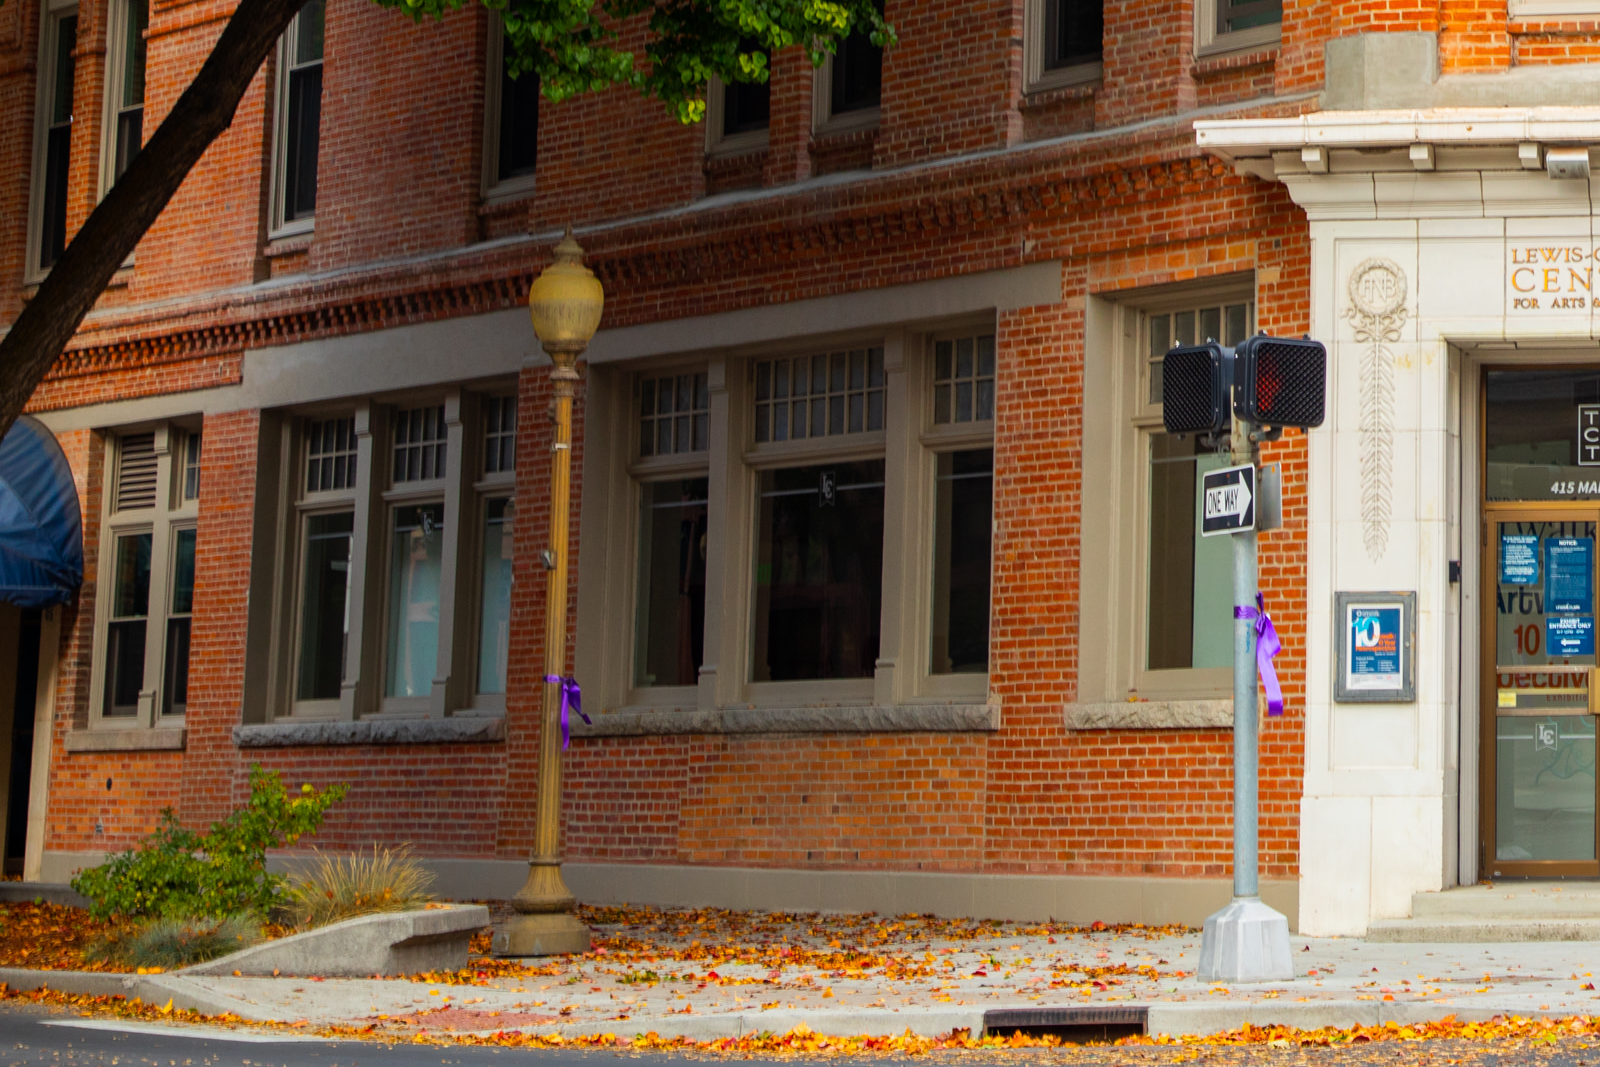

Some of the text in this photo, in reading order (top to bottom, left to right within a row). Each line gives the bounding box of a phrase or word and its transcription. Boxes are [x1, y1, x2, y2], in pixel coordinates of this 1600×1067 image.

[1513, 297, 1540, 309] FOR
[1551, 297, 1586, 309] ARTS
[1550, 481, 1575, 494] 415
[1207, 488, 1239, 515] ONE WAY
[1514, 623, 1540, 656] 10
